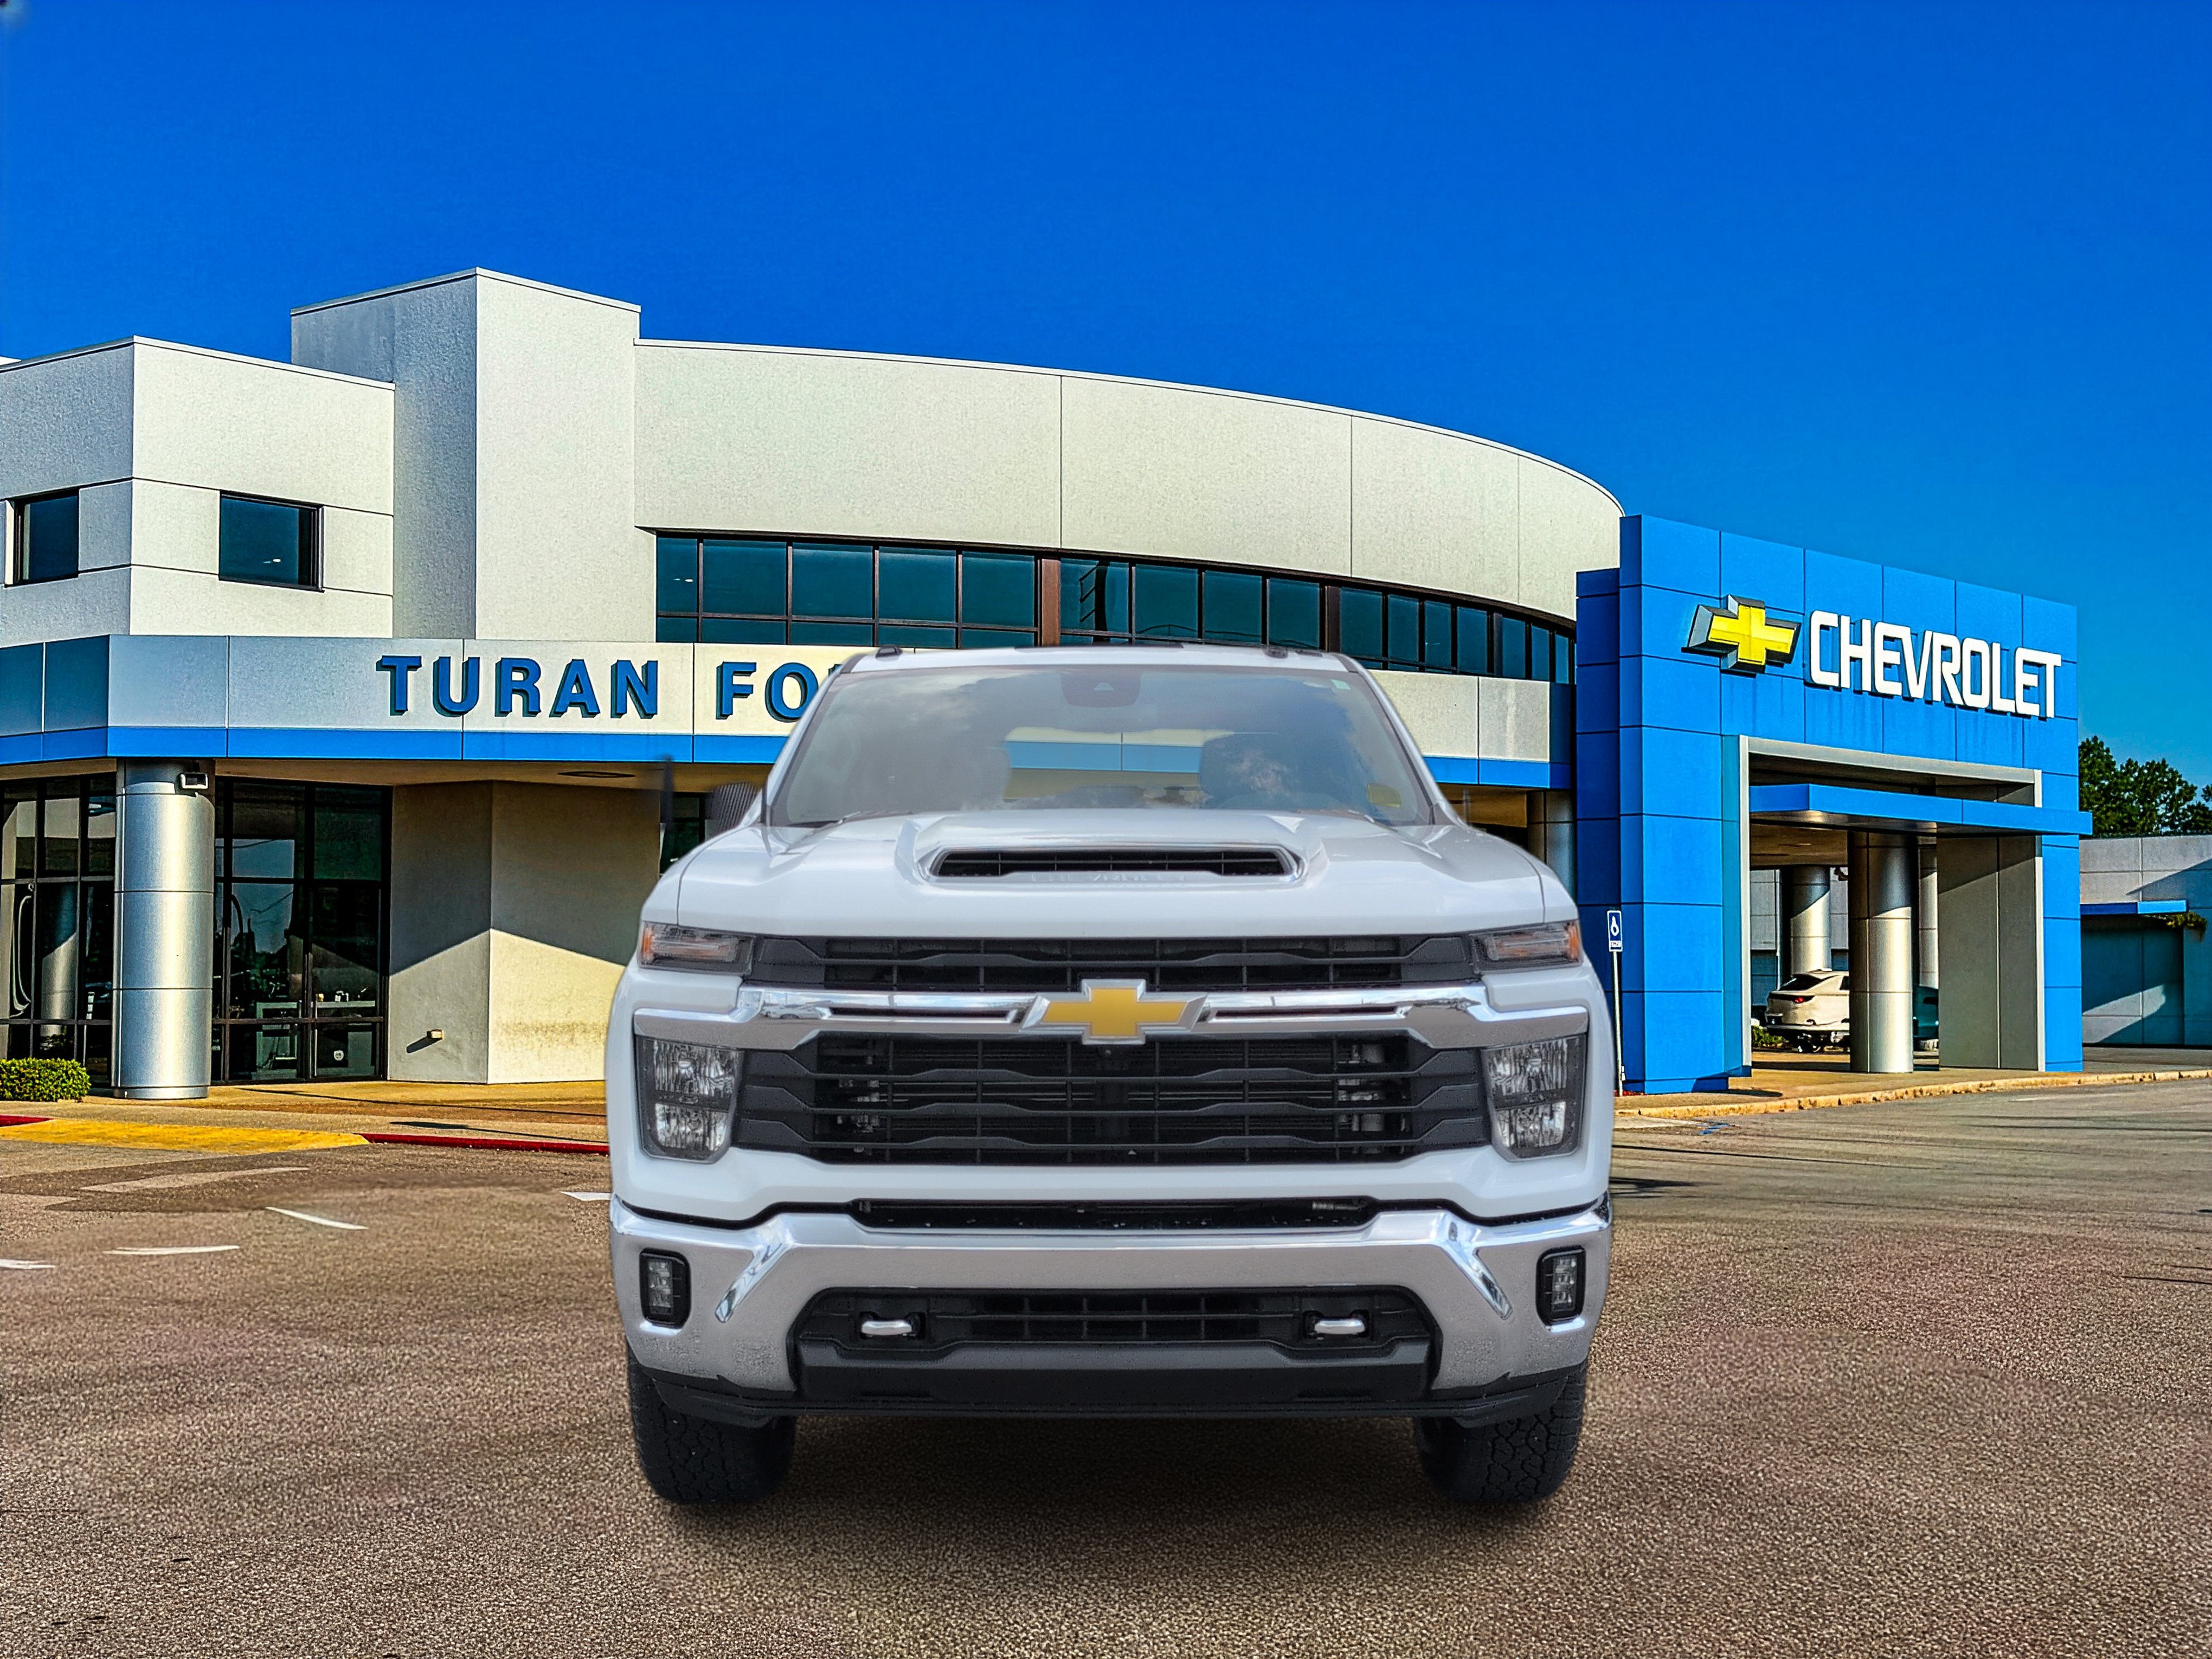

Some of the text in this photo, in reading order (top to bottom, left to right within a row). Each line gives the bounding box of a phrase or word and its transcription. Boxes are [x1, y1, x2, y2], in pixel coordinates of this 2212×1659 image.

[376, 655, 842, 722] TURAN FO
[1810, 610, 2062, 718] CHEVROLET
